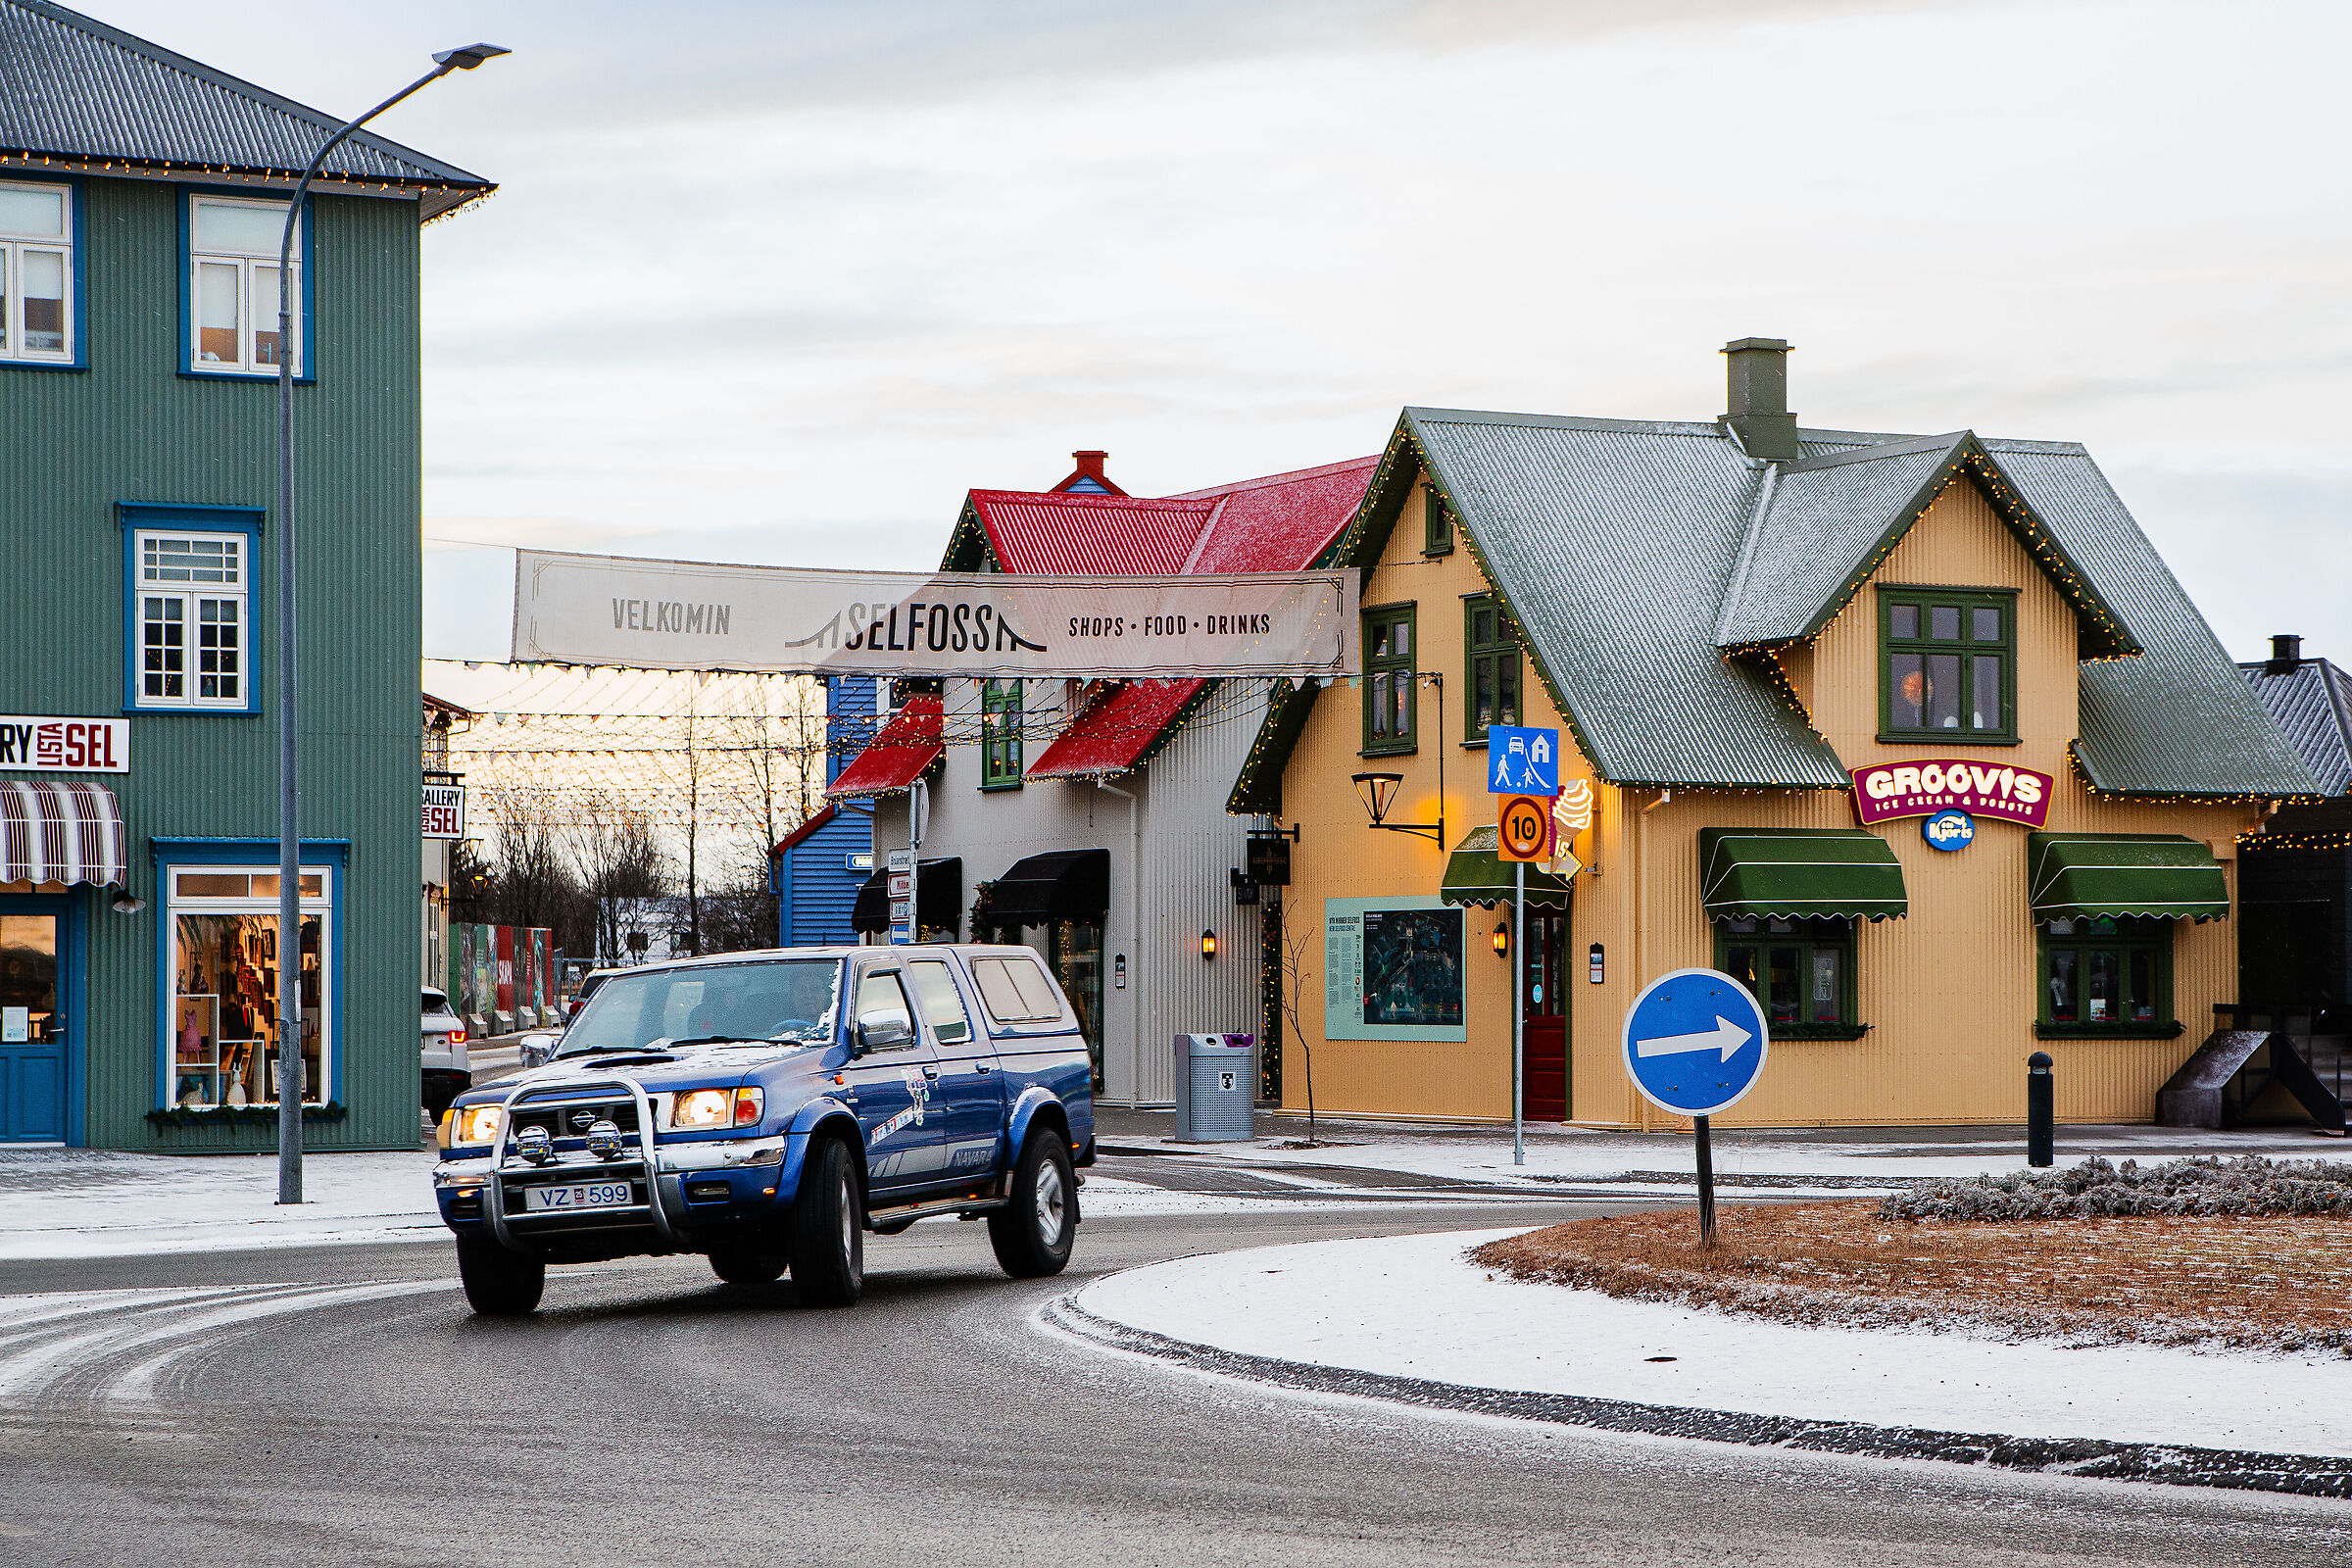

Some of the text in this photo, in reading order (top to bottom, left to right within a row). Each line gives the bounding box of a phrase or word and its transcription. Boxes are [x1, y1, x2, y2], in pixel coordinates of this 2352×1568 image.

[612, 598, 730, 635] VELKOMIN
[845, 602, 993, 652] SELFOSS
[1068, 613, 1270, 637] SHOPS FOOD DRINKS
[37, 723, 63, 765] LISTA
[66, 724, 118, 767] SEL
[422, 789, 461, 807] ALLERY
[1875, 796, 2033, 815] ICE CREAM & DONUTS
[431, 808, 460, 834] SEL
[1512, 815, 1537, 840] 10
[955, 1150, 995, 1167] NAVARA
[539, 1189, 571, 1206] VZ
[589, 1185, 628, 1203] 599
